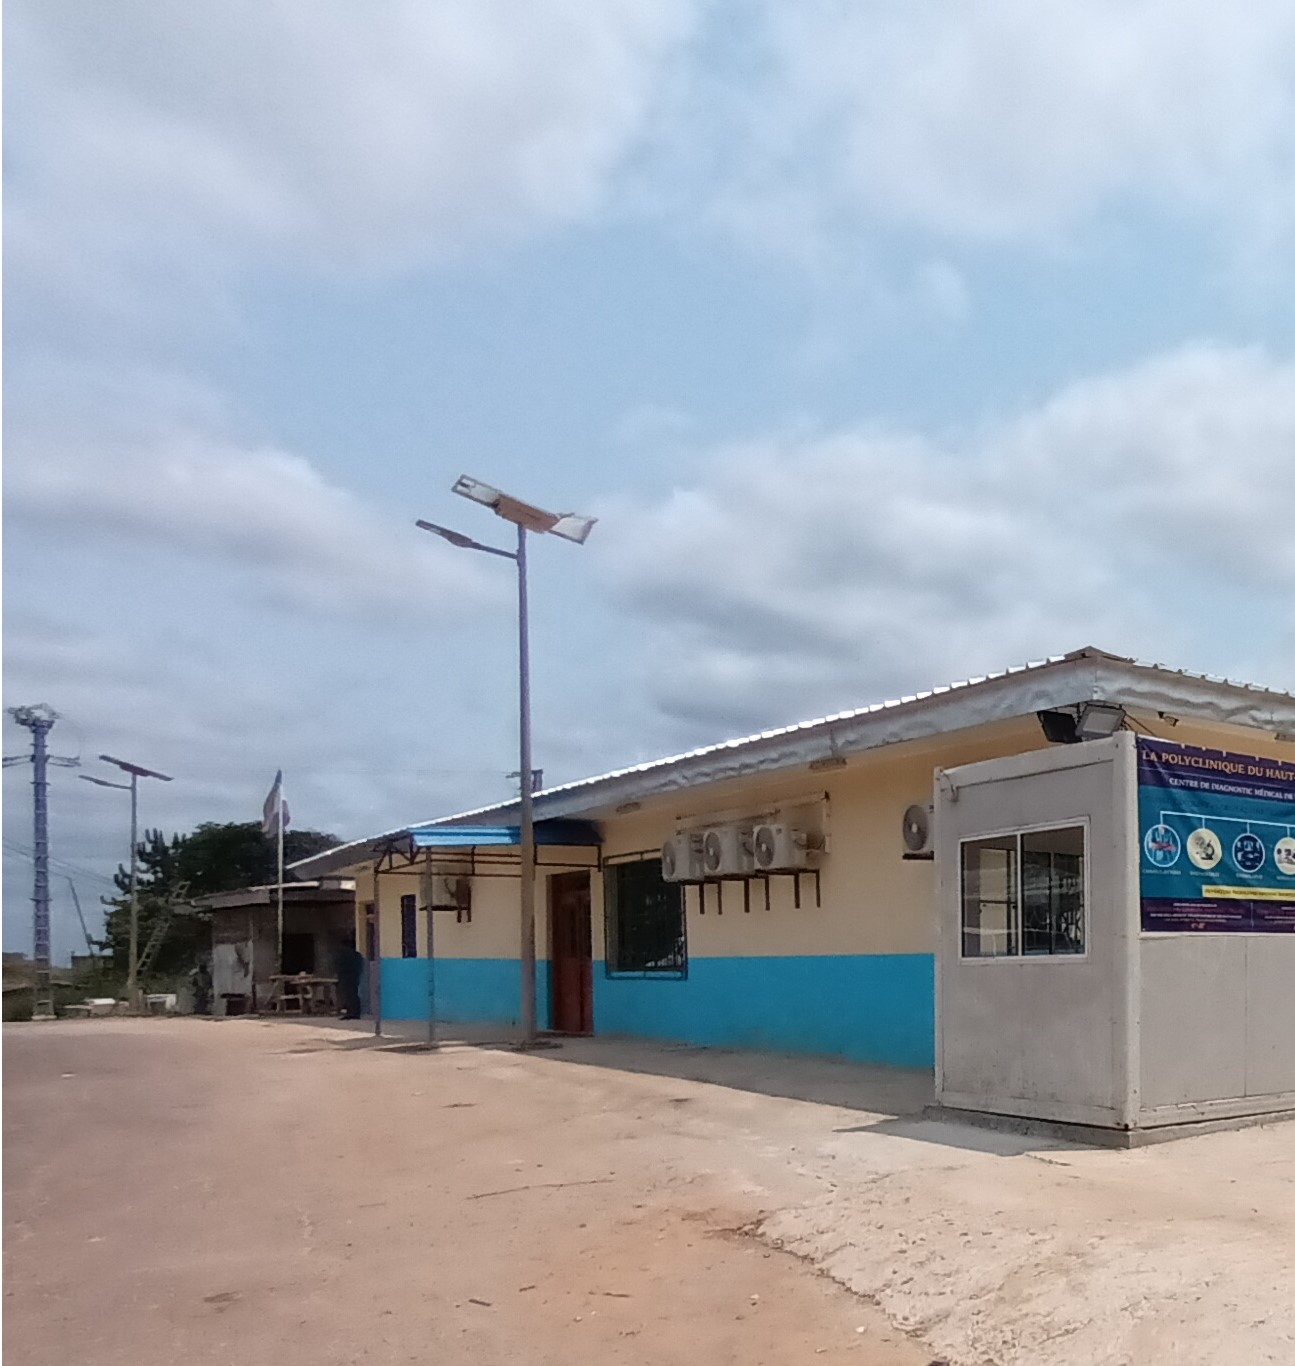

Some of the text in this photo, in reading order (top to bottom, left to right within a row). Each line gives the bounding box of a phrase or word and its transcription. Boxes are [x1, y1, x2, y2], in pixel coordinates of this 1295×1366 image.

[1142, 750, 1157, 762] LA
[1161, 753, 1246, 774] POLYCLINIQUE
[1247, 765, 1263, 777] DU
[1169, 778, 1199, 788] CENTRE
[1200, 781, 1210, 790] DE
[1211, 783, 1253, 795] DIAGNOSTIC
